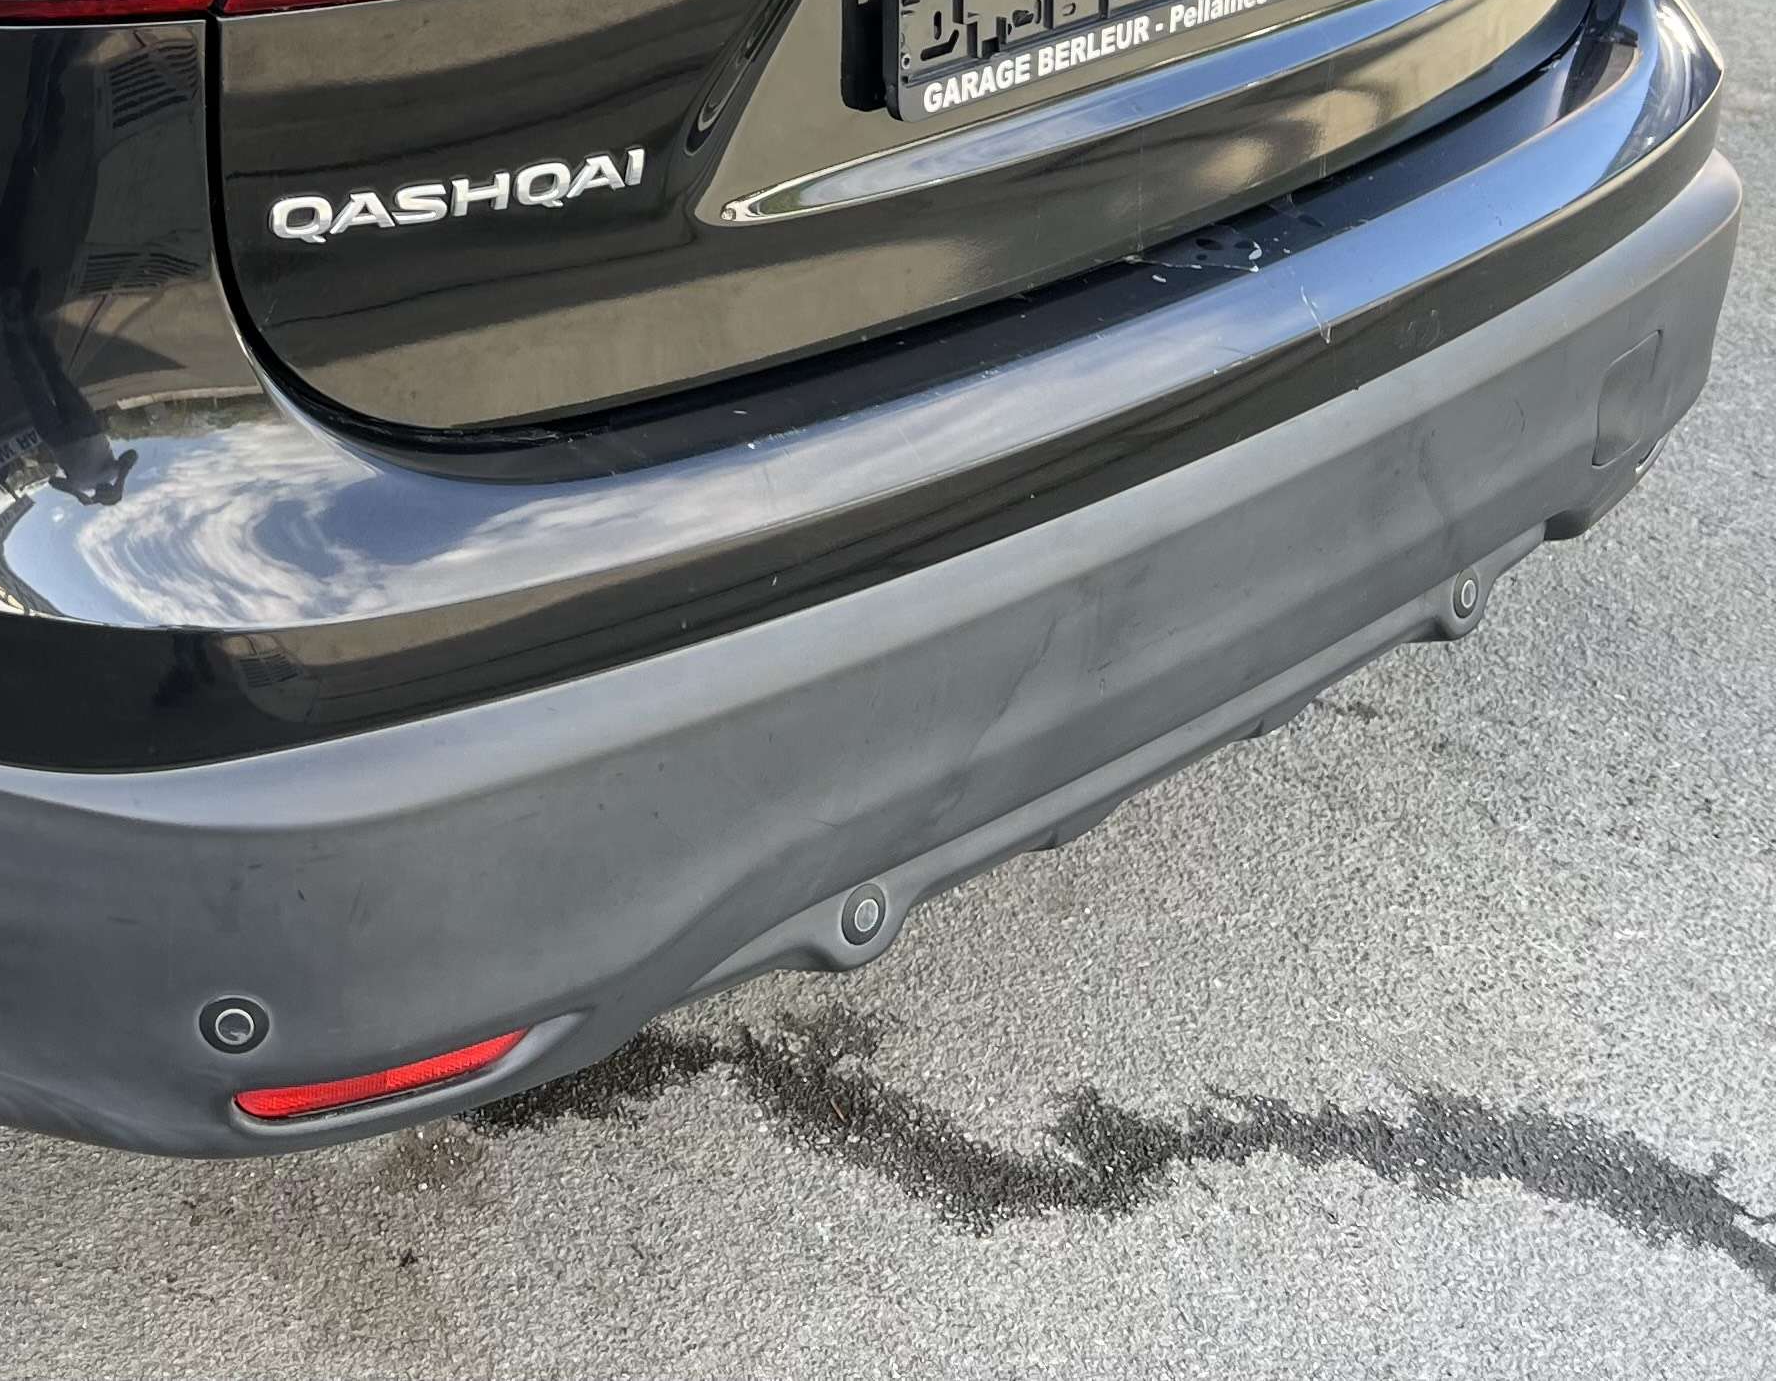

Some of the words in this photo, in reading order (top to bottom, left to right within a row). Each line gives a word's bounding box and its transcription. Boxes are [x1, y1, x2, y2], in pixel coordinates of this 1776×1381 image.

[922, 52, 1032, 114] GARAGE
[1037, 14, 1151, 78] BERLEUR
[269, 147, 646, 244] QASHQAI
